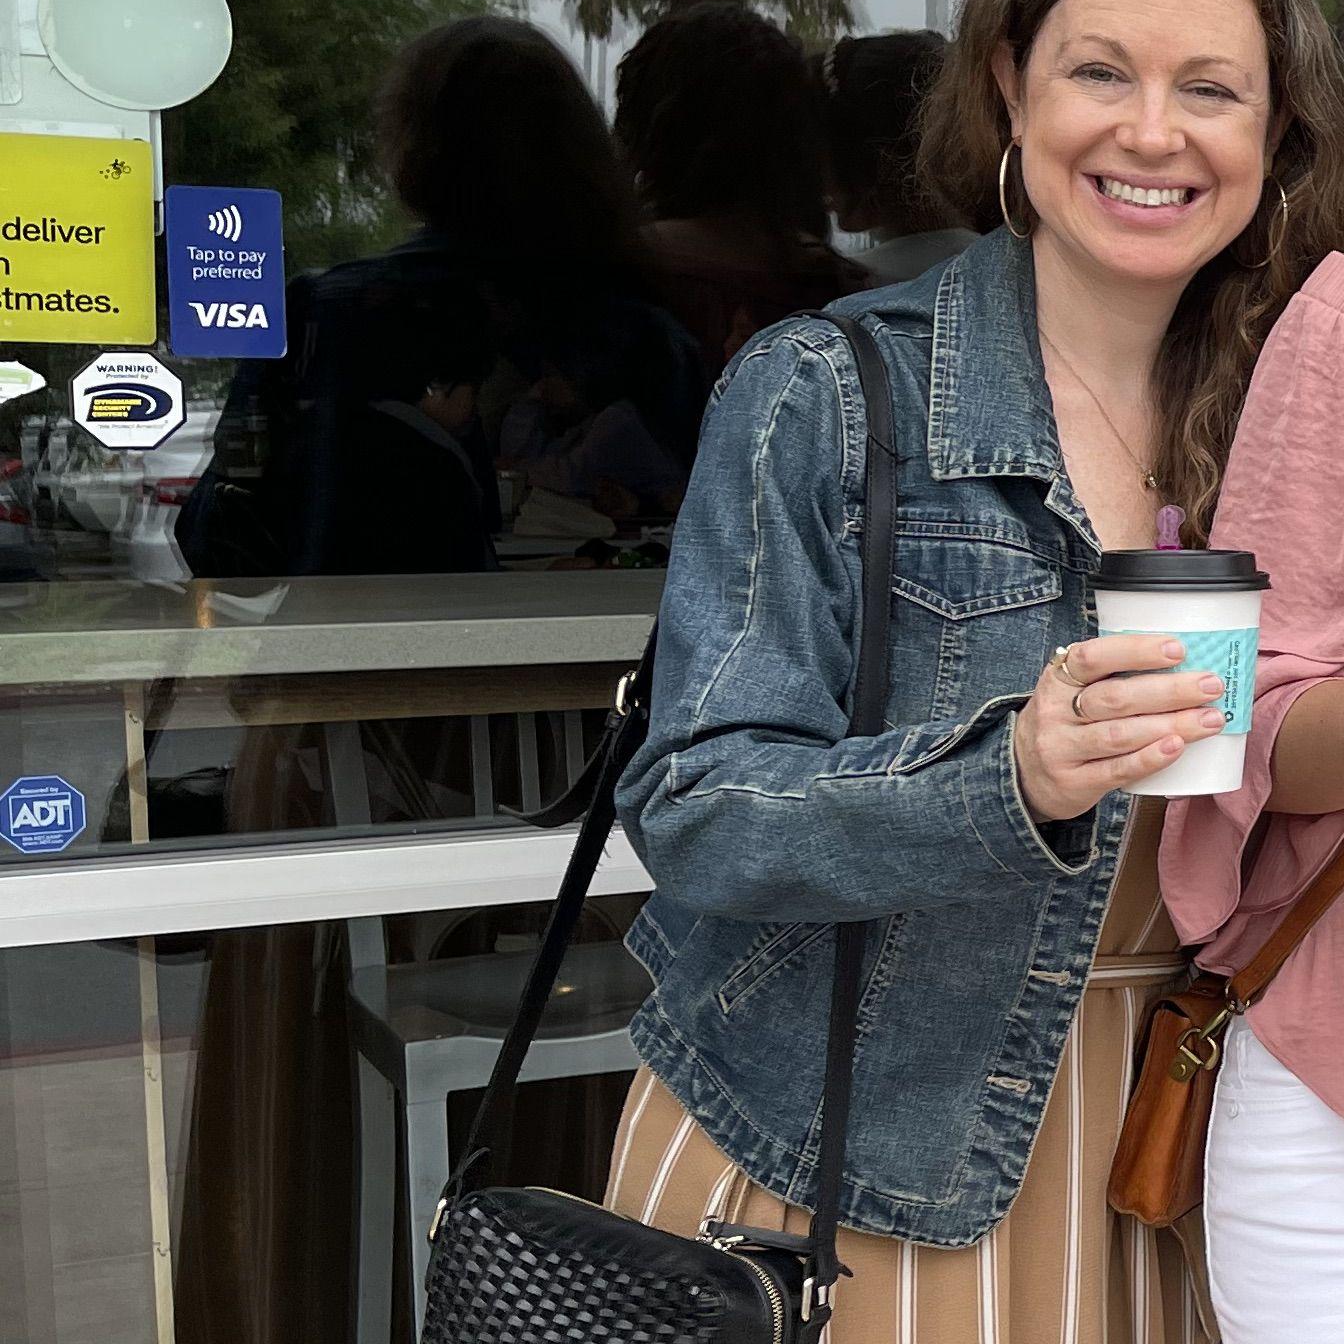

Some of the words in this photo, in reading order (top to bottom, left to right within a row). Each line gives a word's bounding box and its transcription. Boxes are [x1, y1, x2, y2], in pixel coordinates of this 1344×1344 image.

[1, 217, 106, 244] deliver
[187, 246, 214, 262] Tap
[219, 249, 235, 262] to
[239, 252, 266, 266] pay
[192, 264, 262, 280] preferred
[188, 302, 269, 329] VISA
[96, 365, 158, 374] WARNING!
[12, 799, 70, 829] ADT
